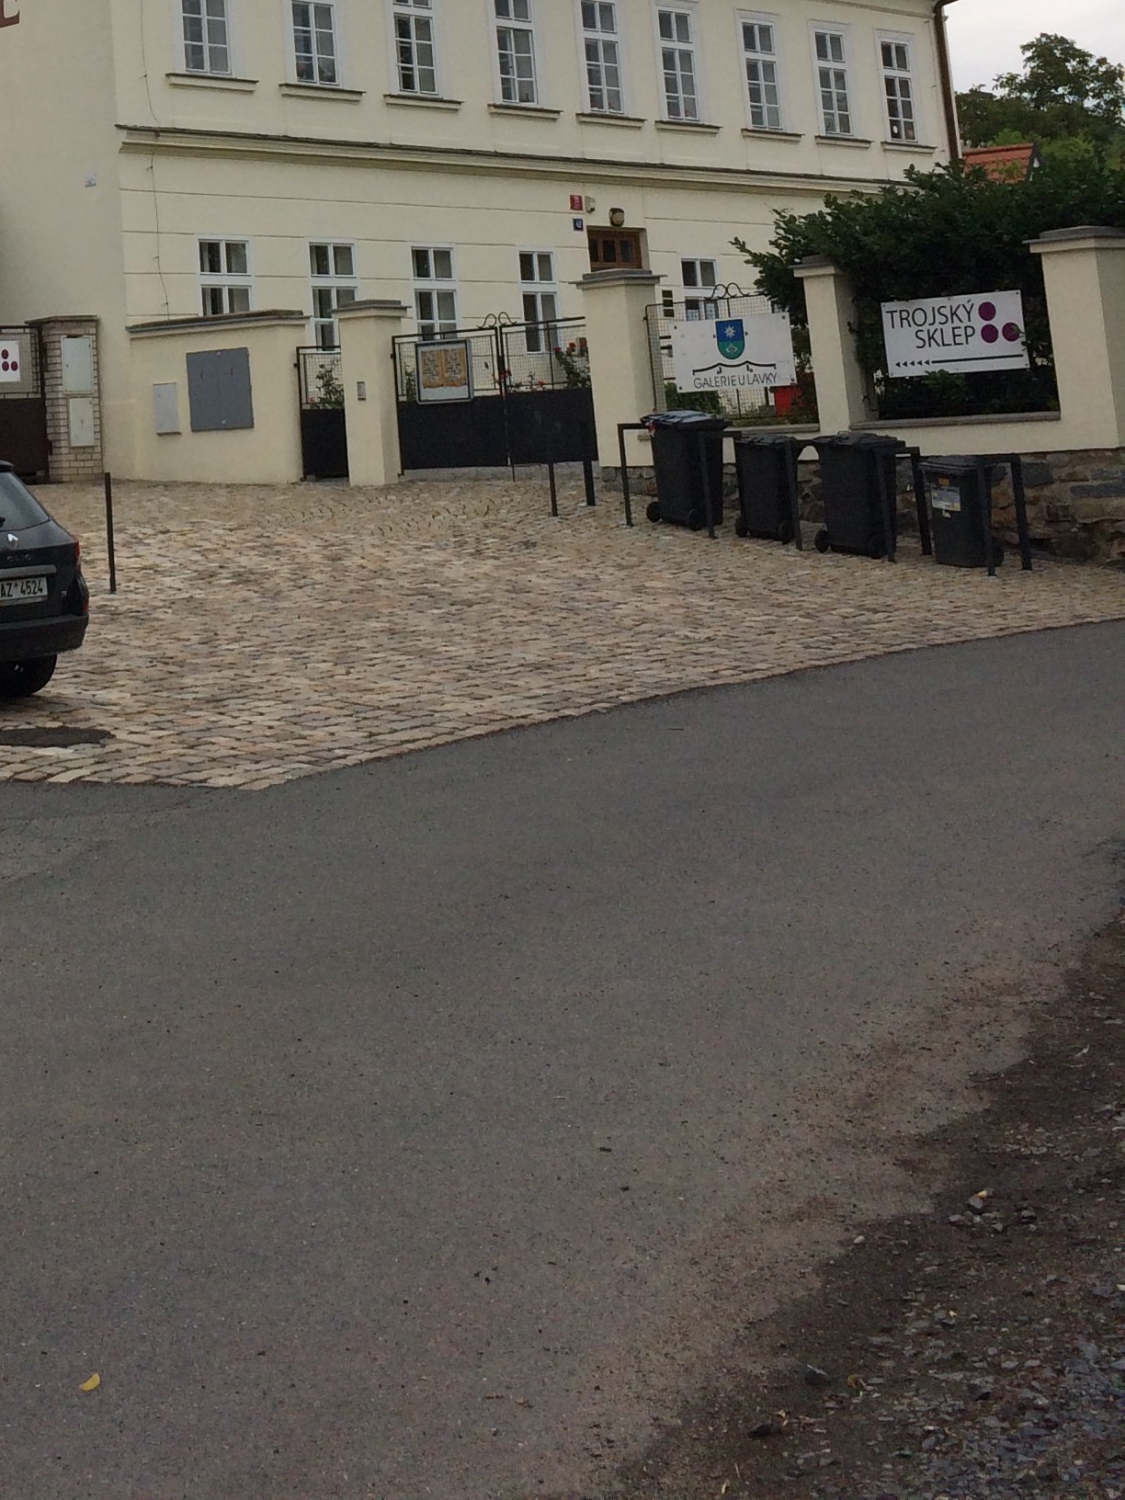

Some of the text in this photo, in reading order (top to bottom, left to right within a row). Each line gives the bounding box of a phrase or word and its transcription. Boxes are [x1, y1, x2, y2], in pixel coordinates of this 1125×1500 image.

[885, 299, 975, 330] TROJSKÝ
[914, 325, 976, 349] SKLEP
[693, 375, 737, 389] GALERIE
[19, 579, 44, 596] 4524
